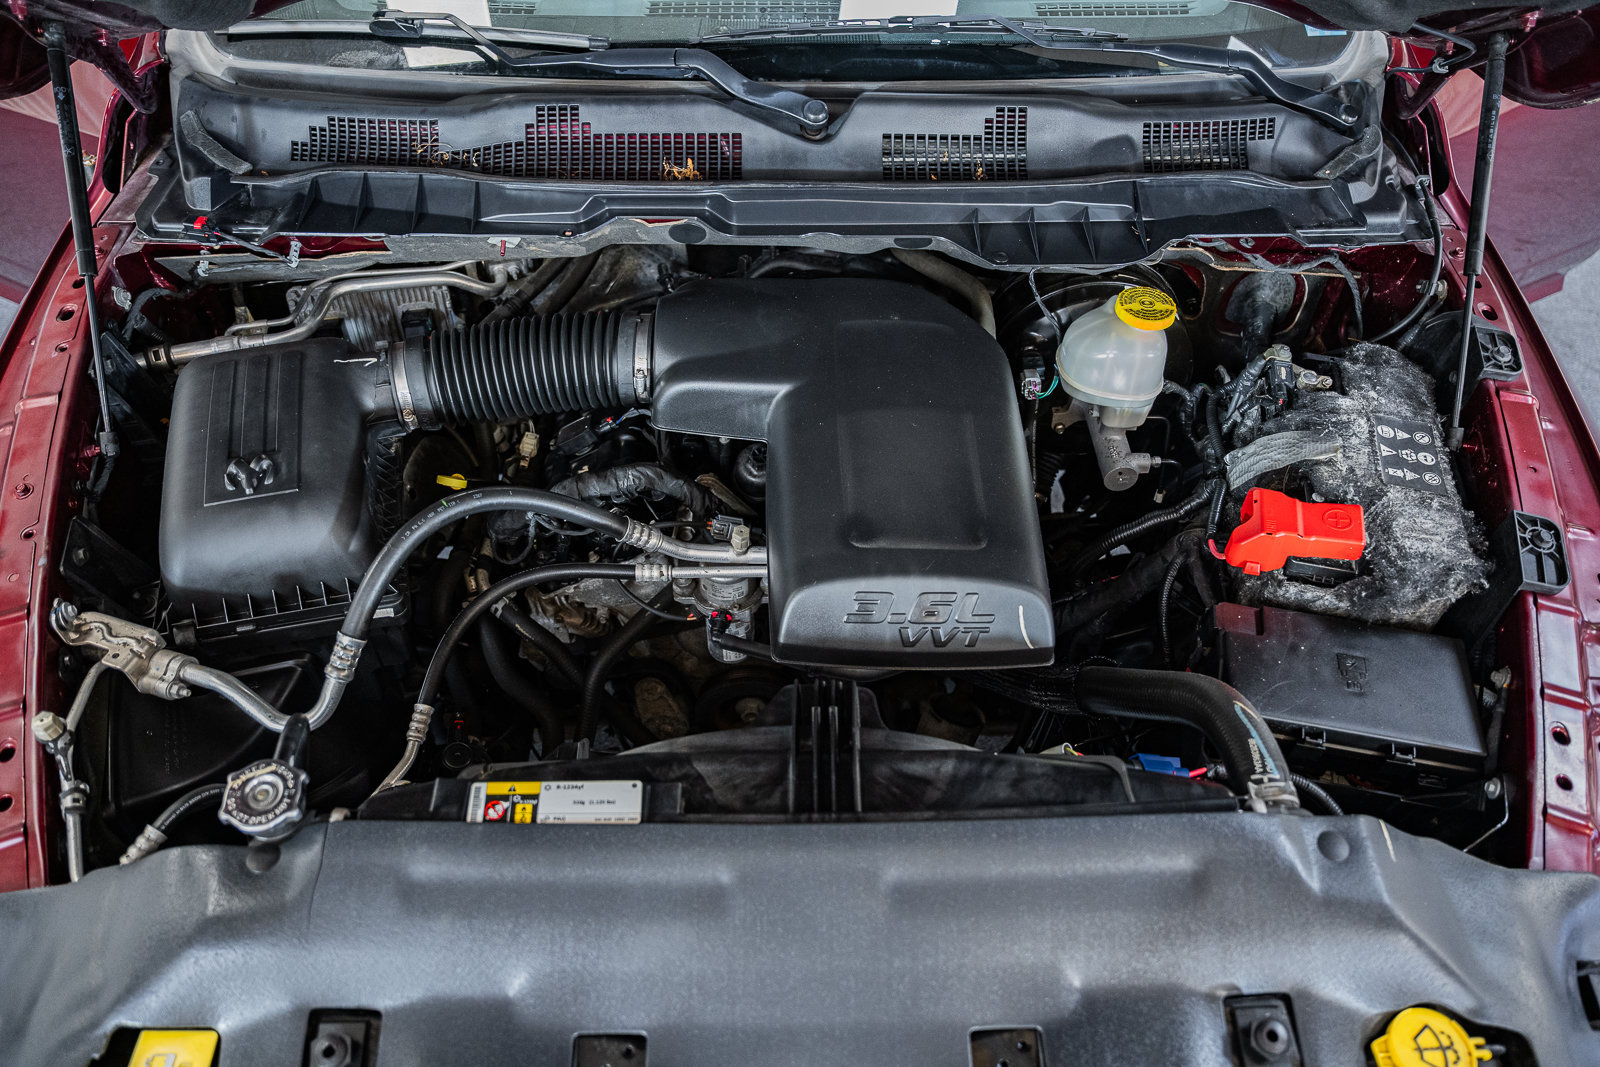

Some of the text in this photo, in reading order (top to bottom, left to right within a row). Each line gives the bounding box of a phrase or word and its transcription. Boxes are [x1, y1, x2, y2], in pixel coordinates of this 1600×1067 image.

[843, 590, 996, 625] 3.6L
[898, 626, 991, 648] VVT
[249, 813, 275, 824] OPEN
